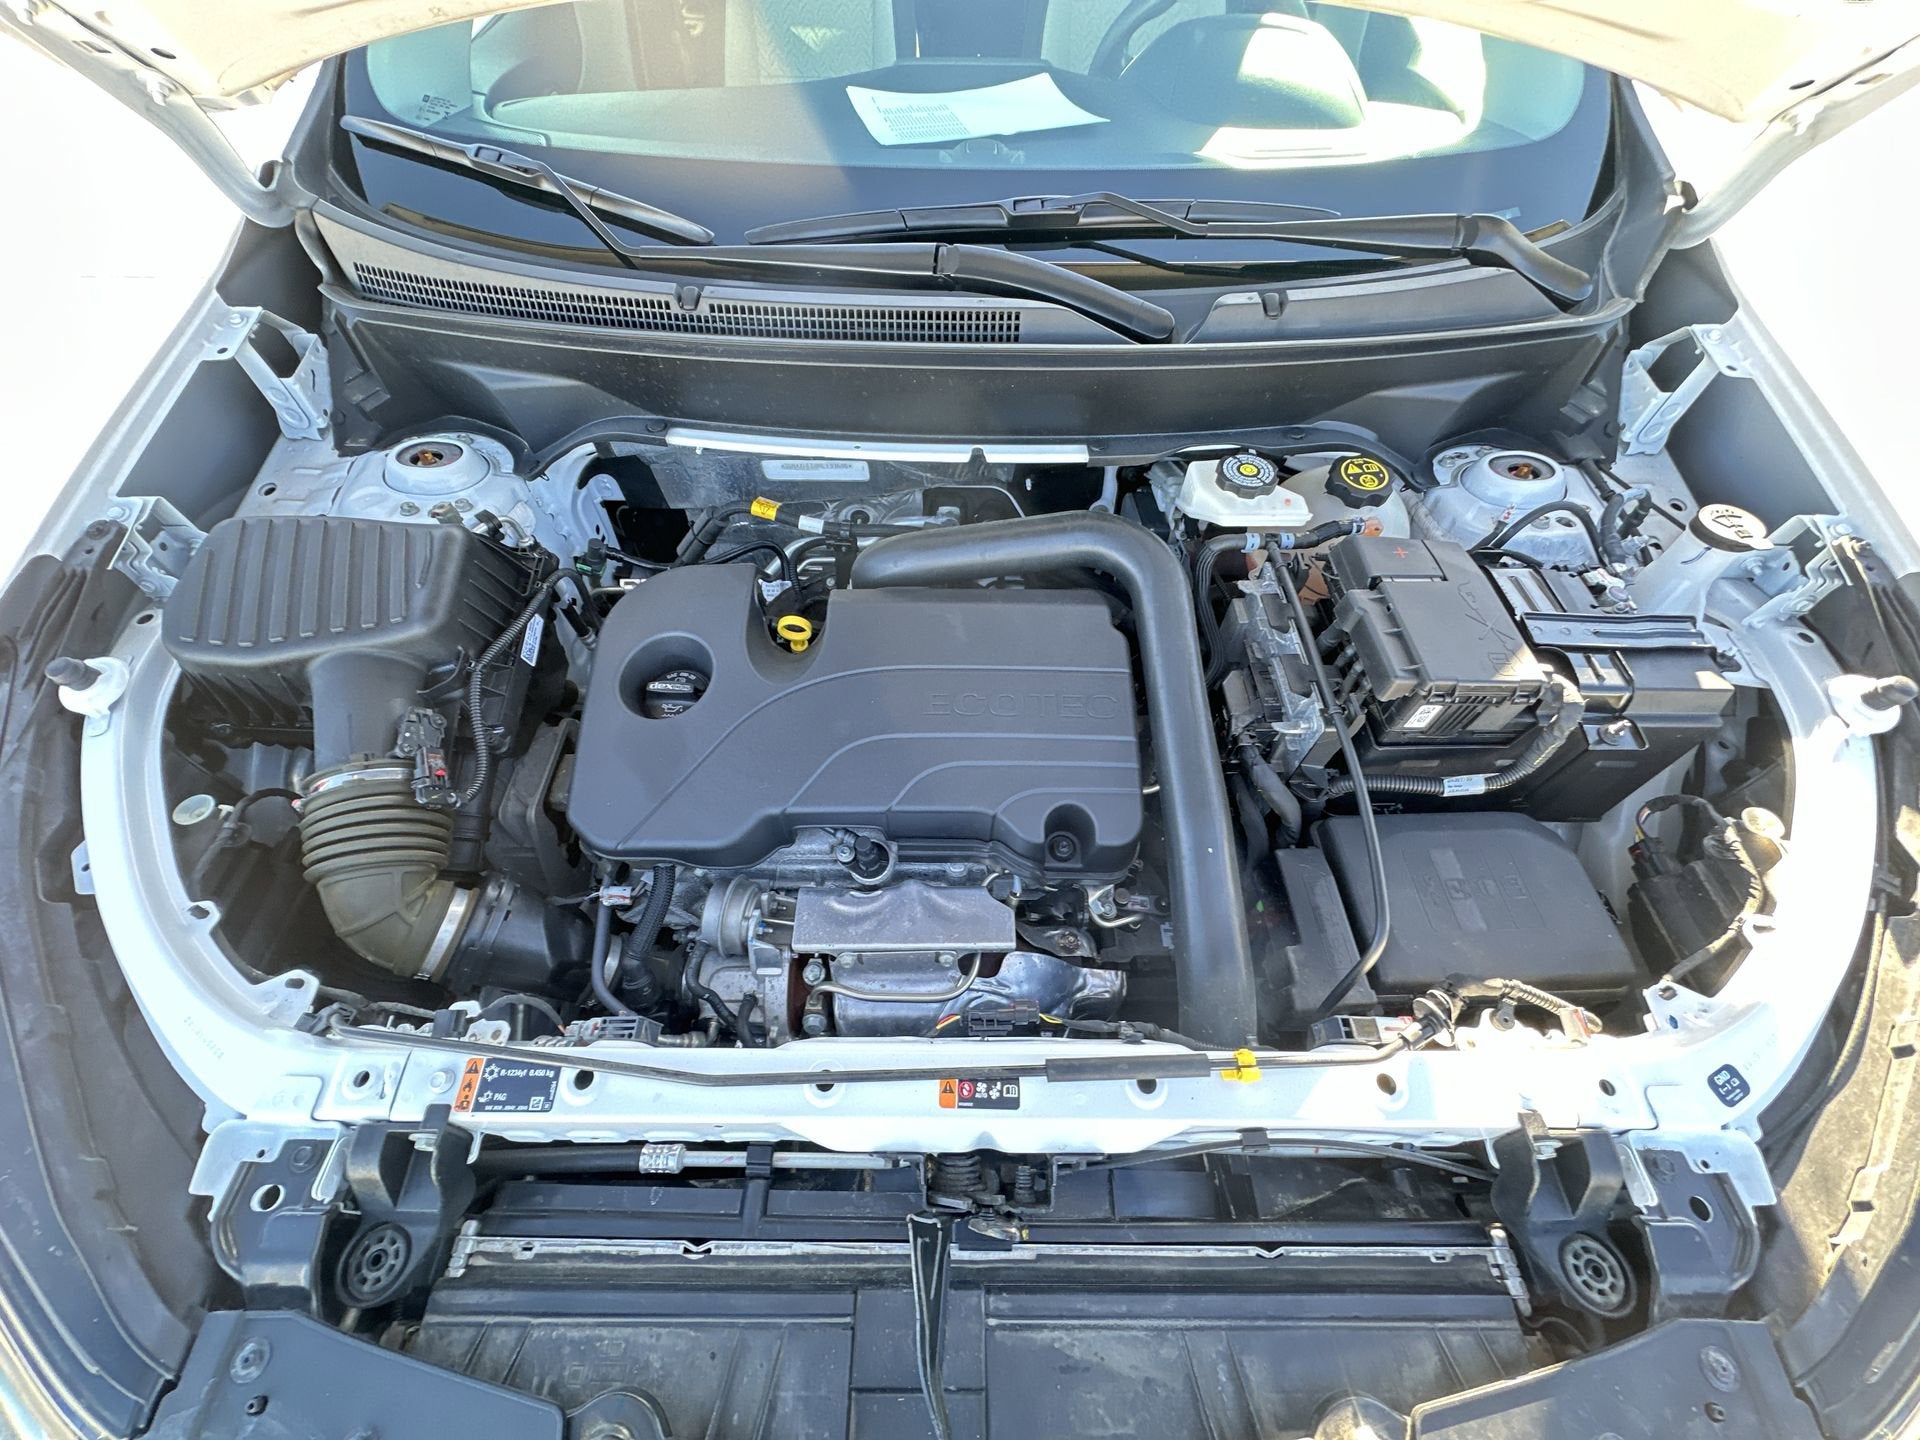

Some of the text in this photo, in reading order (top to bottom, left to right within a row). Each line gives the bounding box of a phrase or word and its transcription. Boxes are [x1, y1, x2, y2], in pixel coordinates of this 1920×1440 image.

[922, 692, 1119, 720] ECOTEC
[545, 1069, 555, 1078] kg
[493, 1093, 508, 1101] PAG
